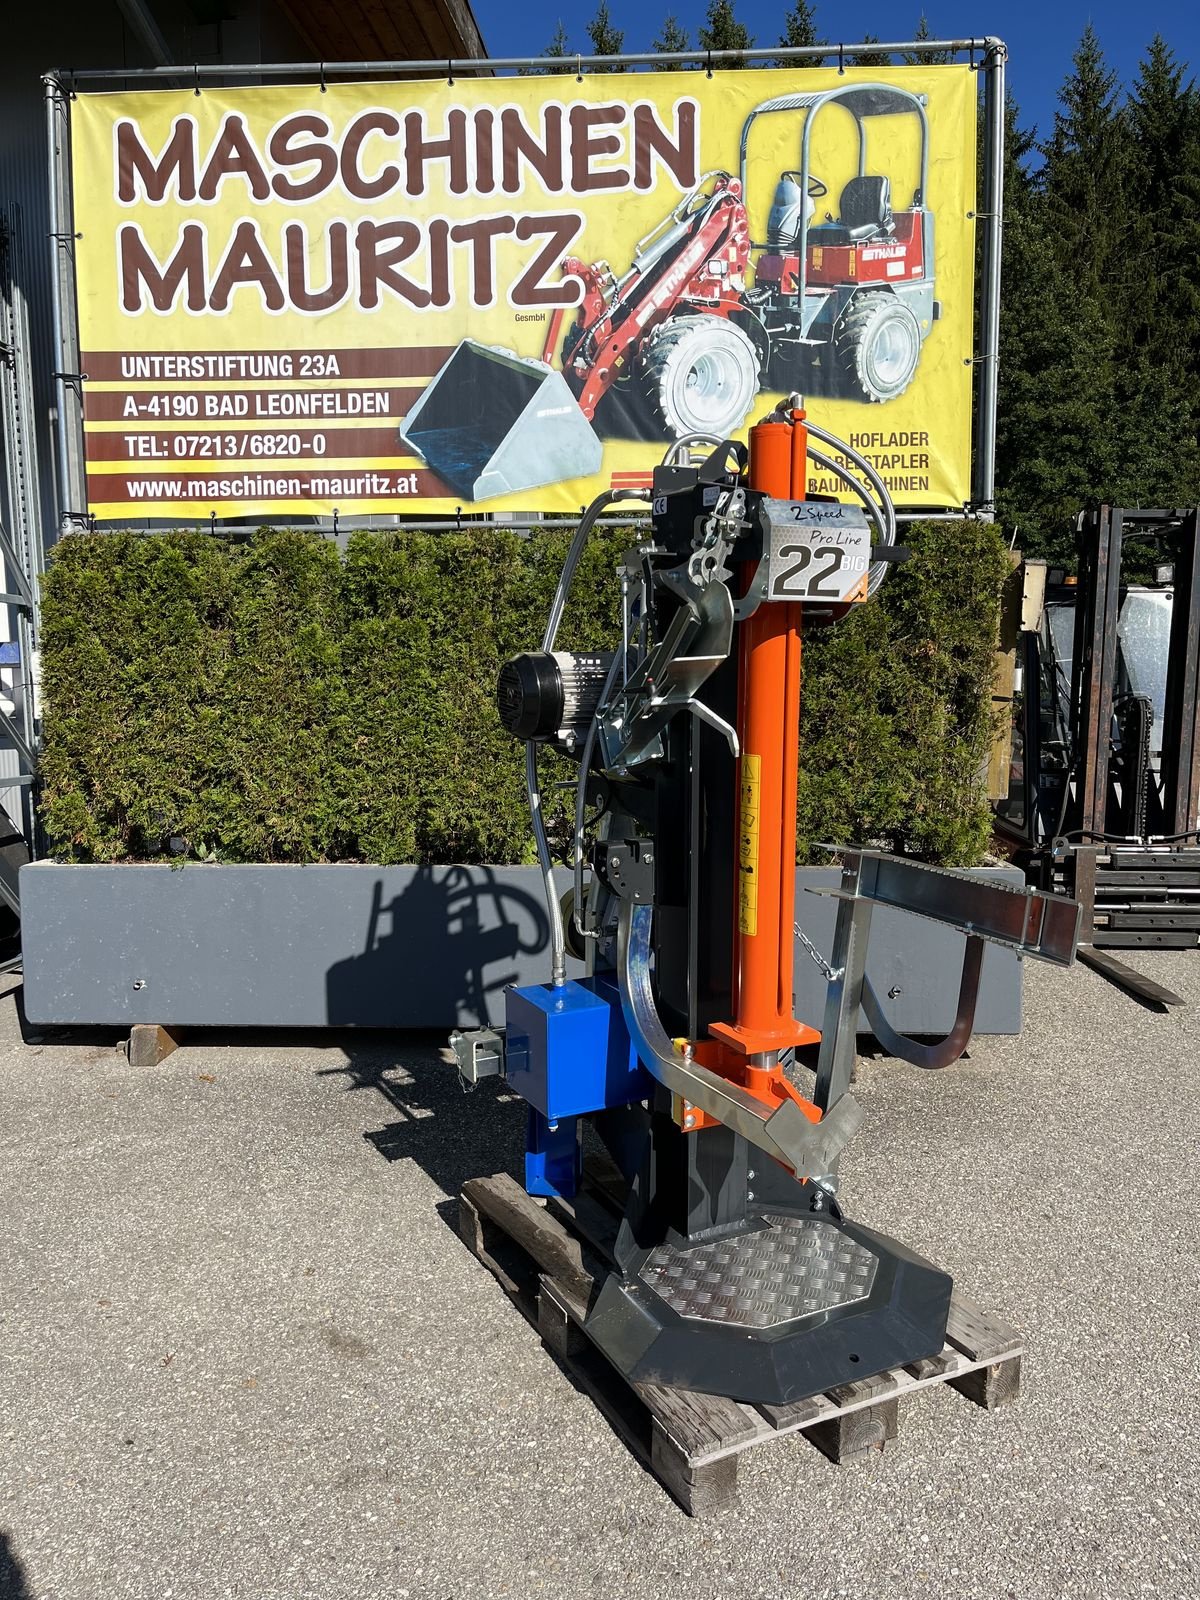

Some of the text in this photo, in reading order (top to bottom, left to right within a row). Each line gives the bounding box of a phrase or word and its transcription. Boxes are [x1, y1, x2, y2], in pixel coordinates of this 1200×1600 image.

[117, 101, 697, 202] MASCHINEN
[120, 214, 582, 312] MAURITZ
[515, 313, 546, 322] GesmbH
[121, 354, 341, 378] UNTERSTIFTUNG 23A
[123, 392, 390, 417] A-4190 BAD LEONFELDEN
[124, 434, 326, 457] TEL: 07213/6820-0
[849, 431, 929, 448] HOFLADER
[813, 453, 929, 471] BESTAPLER
[126, 473, 418, 498] www.maschinen-mauritz.at
[808, 476, 929, 493] BAUMSHINEN
[790, 506, 846, 522] 2 Speed
[809, 530, 862, 546] Pro Line
[772, 544, 846, 598] 22
[841, 554, 866, 573] BIG
